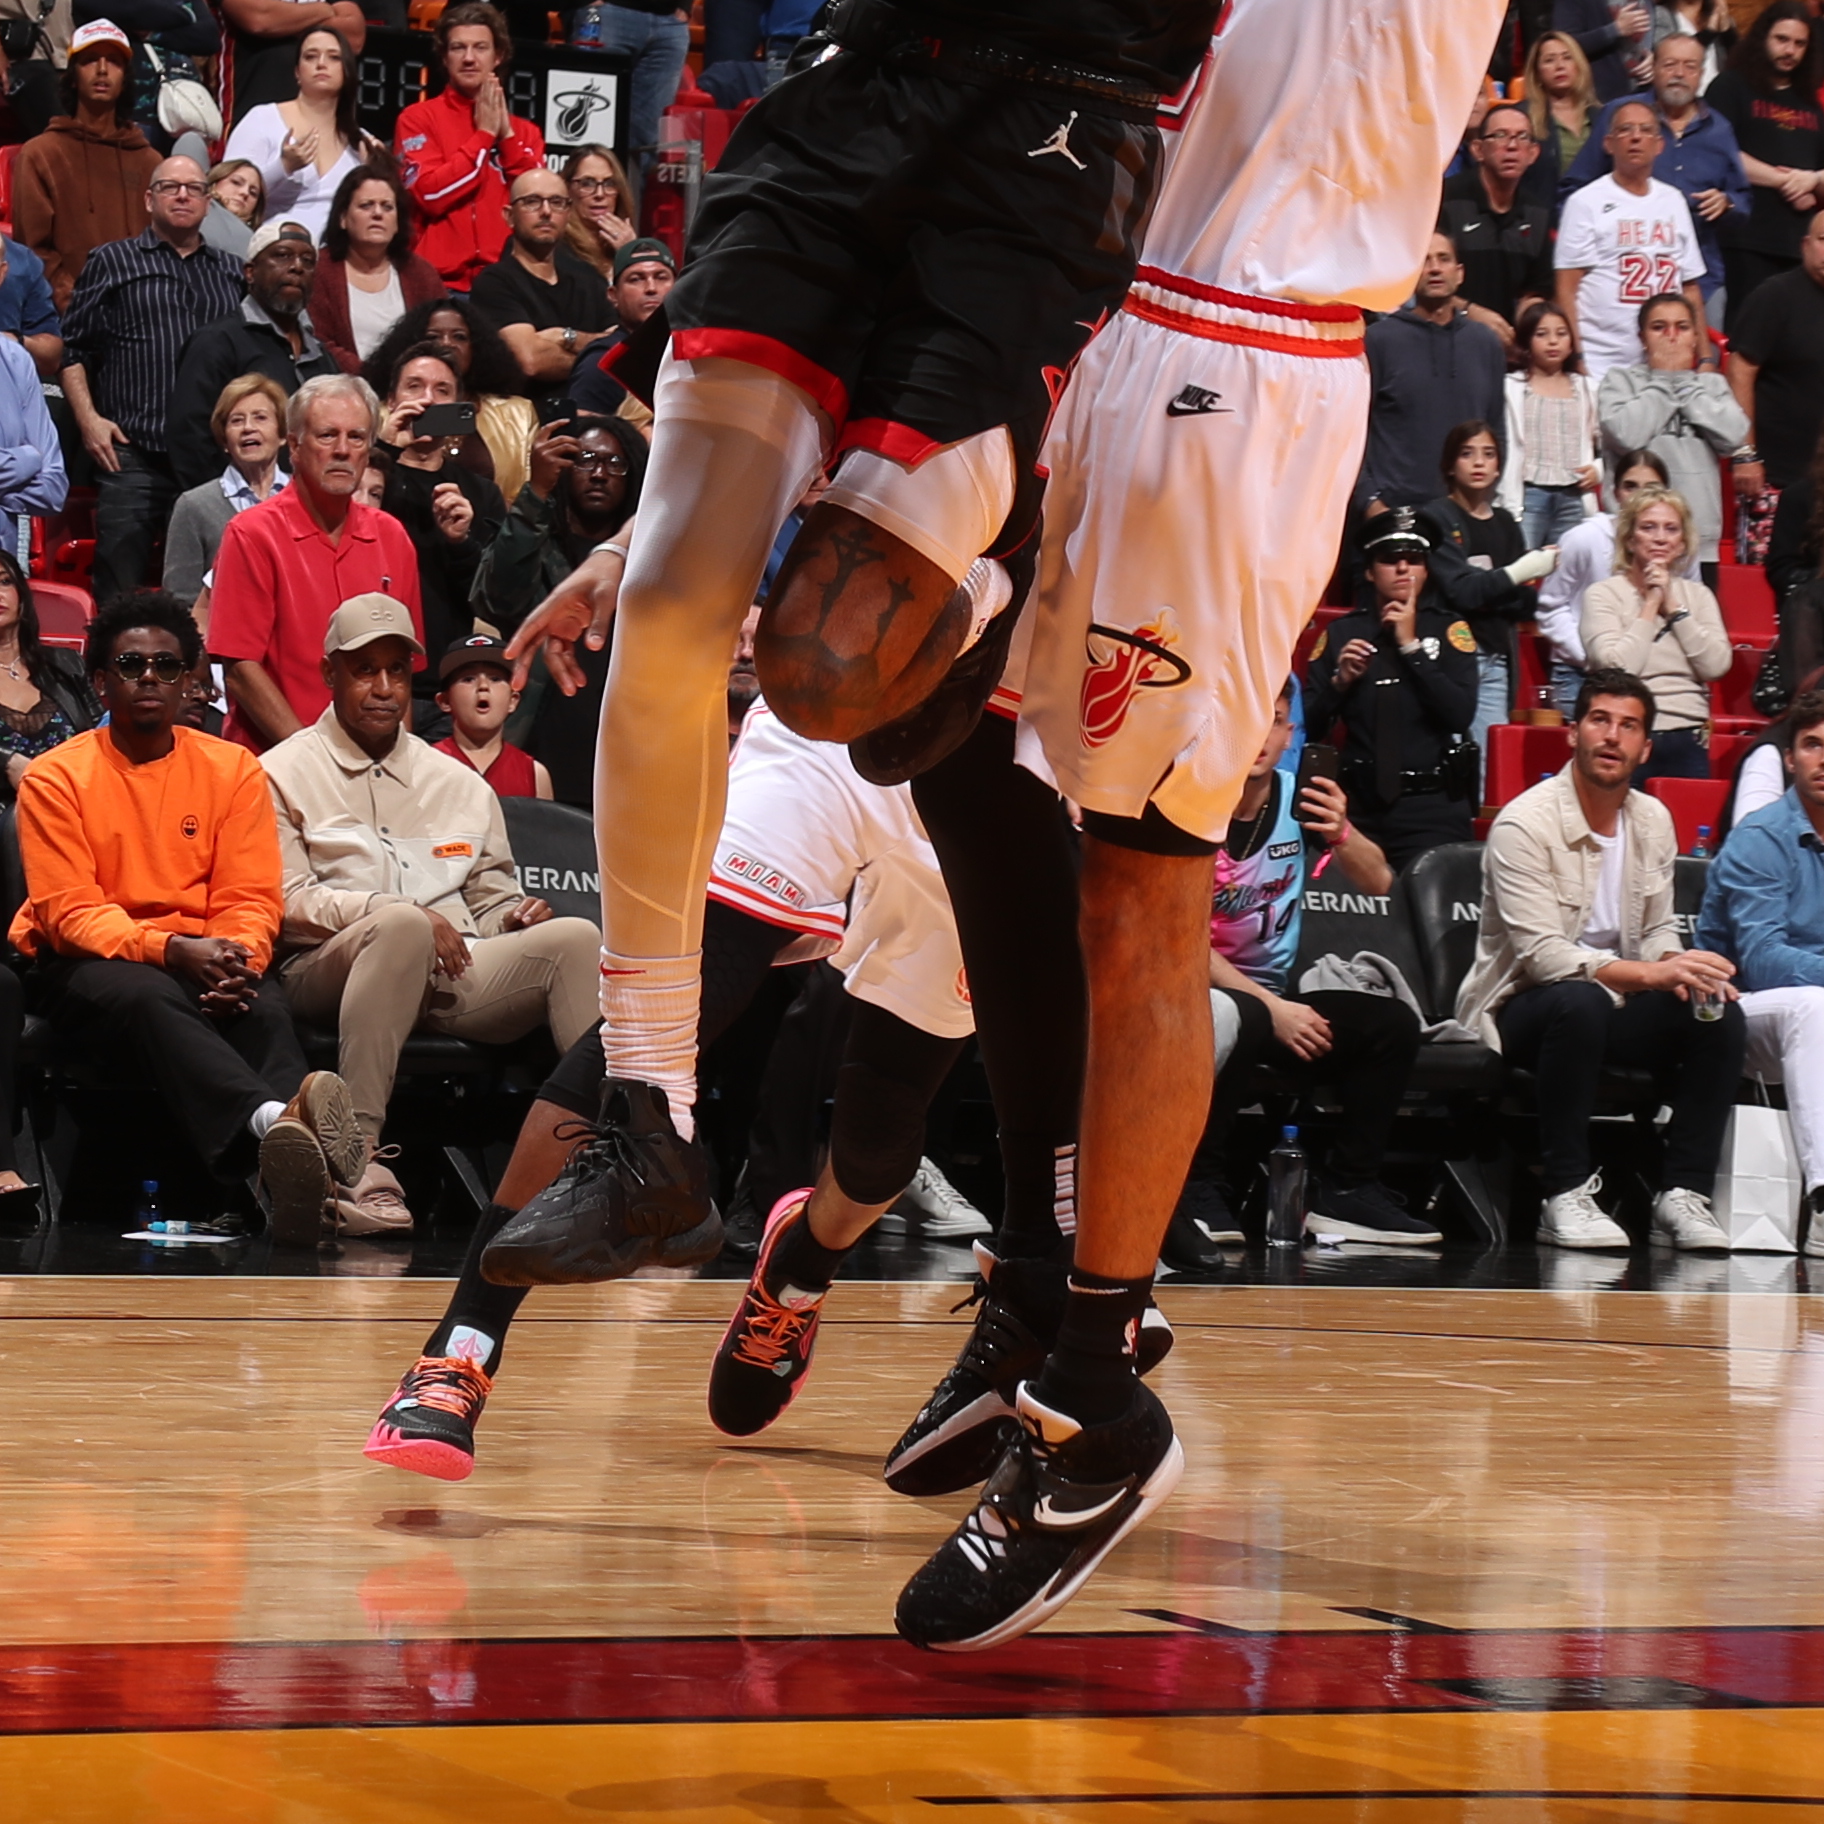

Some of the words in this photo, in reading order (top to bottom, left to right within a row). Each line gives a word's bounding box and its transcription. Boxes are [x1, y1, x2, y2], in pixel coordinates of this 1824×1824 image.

[1620, 254, 1681, 304] 22
[1176, 383, 1223, 412] NIKE
[514, 865, 601, 895] ERAN
[725, 853, 808, 911] MIAMI
